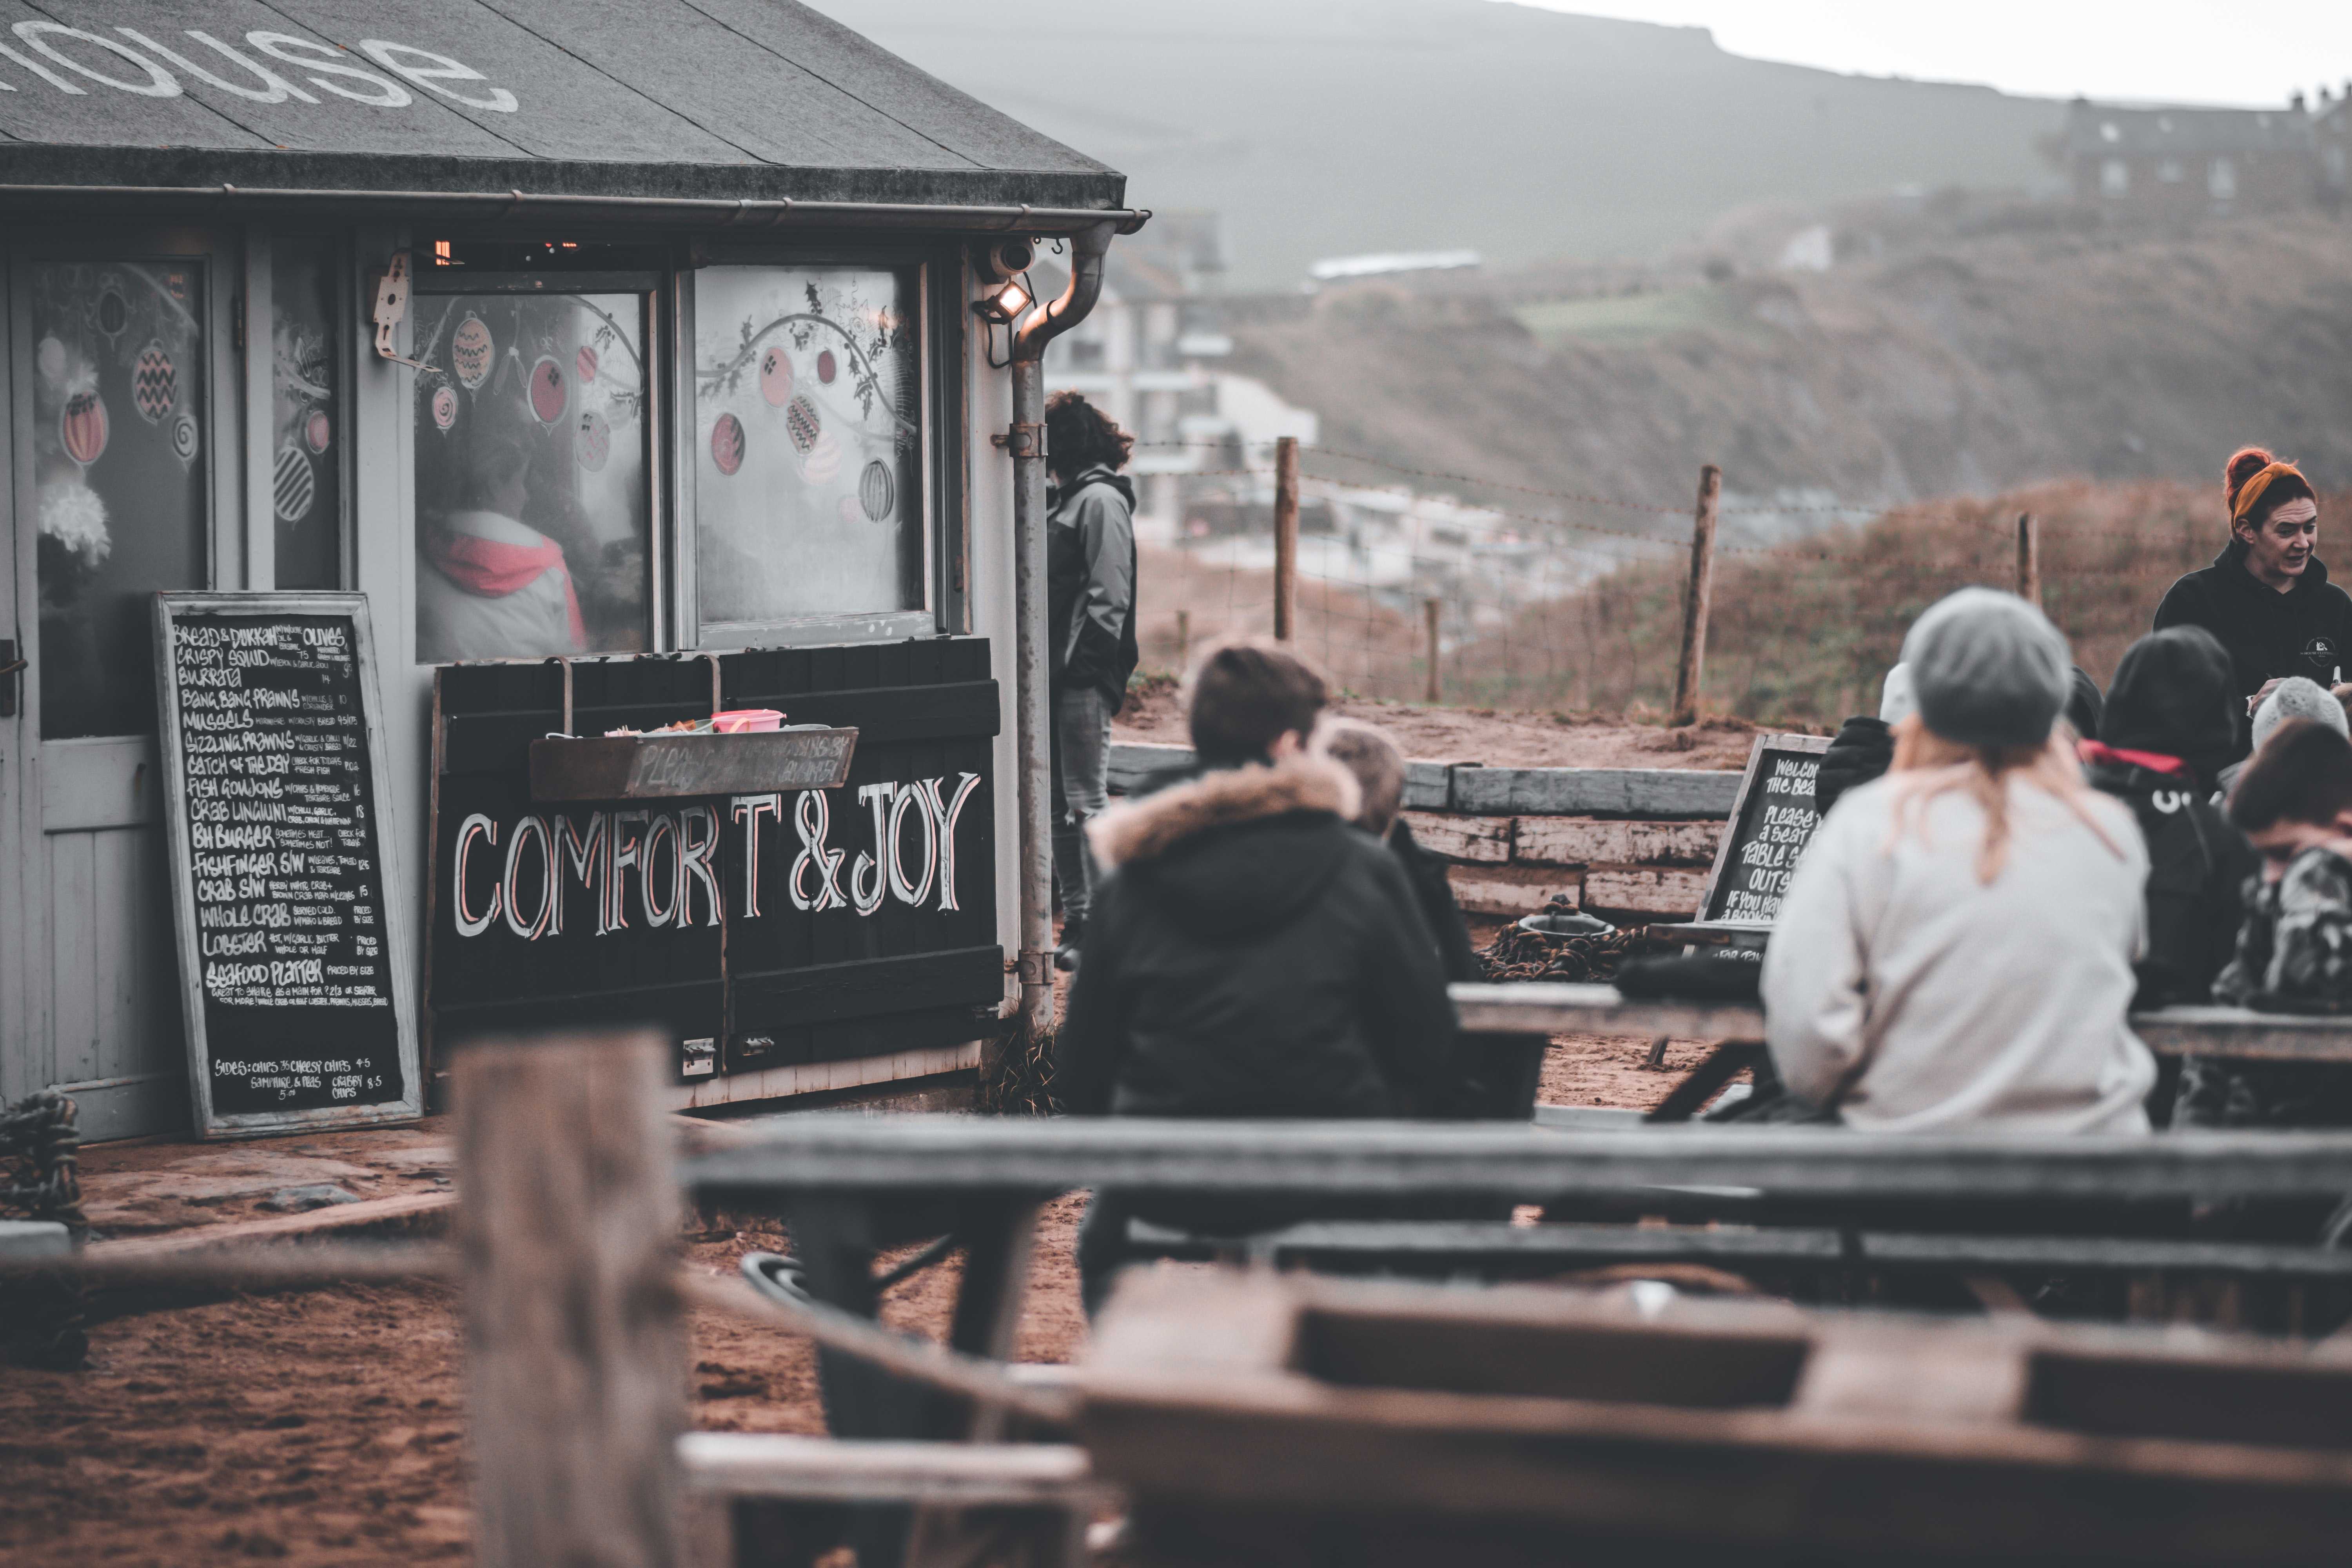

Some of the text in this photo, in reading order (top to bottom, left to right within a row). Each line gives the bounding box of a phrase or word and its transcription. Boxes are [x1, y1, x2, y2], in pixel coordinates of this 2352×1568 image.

[173, 624, 278, 649] BREAD & DUKKAH
[303, 627, 345, 647] OLIVES
[177, 646, 270, 670] CRISPY SQUID
[178, 666, 242, 687] BURRATA
[181, 688, 300, 710] BANG BANG PRAWNS
[183, 709, 254, 731] MUSSELS
[317, 717, 336, 726] BREAD
[185, 730, 295, 754] SIZZLING PRAWNS
[187, 753, 290, 775] CATCH OF THE DAY
[316, 766, 331, 775] FISH
[186, 777, 283, 799] FISH GOUJONS
[1767, 777, 1791, 793] THE
[191, 798, 287, 823] CRAB LINGUINI
[356, 805, 365, 818] 18
[1764, 806, 1813, 829] PLEASE
[192, 822, 276, 851] BH BURGER
[1771, 827, 1808, 846] SEAT
[280, 850, 305, 877] S/W
[454, 772, 981, 942] COMFORT & JOY
[1741, 840, 1785, 867] TABLE
[198, 873, 265, 902] CRAB S/W
[294, 891, 313, 900] CRAB
[359, 884, 368, 897] 15
[354, 906, 372, 915] PRICED
[1726, 890, 1788, 914] IF YOU HAV
[200, 902, 292, 928] WHOLE CRAB
[203, 930, 267, 956] LOBSTER
[299, 946, 309, 955] OR
[357, 946, 365, 956] BY
[357, 935, 377, 946] PRICED
[205, 958, 374, 988] SEAFOOD PLATTER PRICED BY SIZE
[211, 987, 234, 997] GREAT
[235, 987, 245, 996] TO
[246, 985, 273, 998] SHARE
[292, 986, 309, 996] MAIN
[252, 1062, 279, 1073] CHIPS
[290, 1060, 323, 1074] CHEESY
[324, 1060, 351, 1073] CHIPS
[250, 1076, 321, 1089] SAMPHIRE & PEAS
[332, 1075, 363, 1088] CRABBY
[332, 1087, 357, 1099] CHIPS
